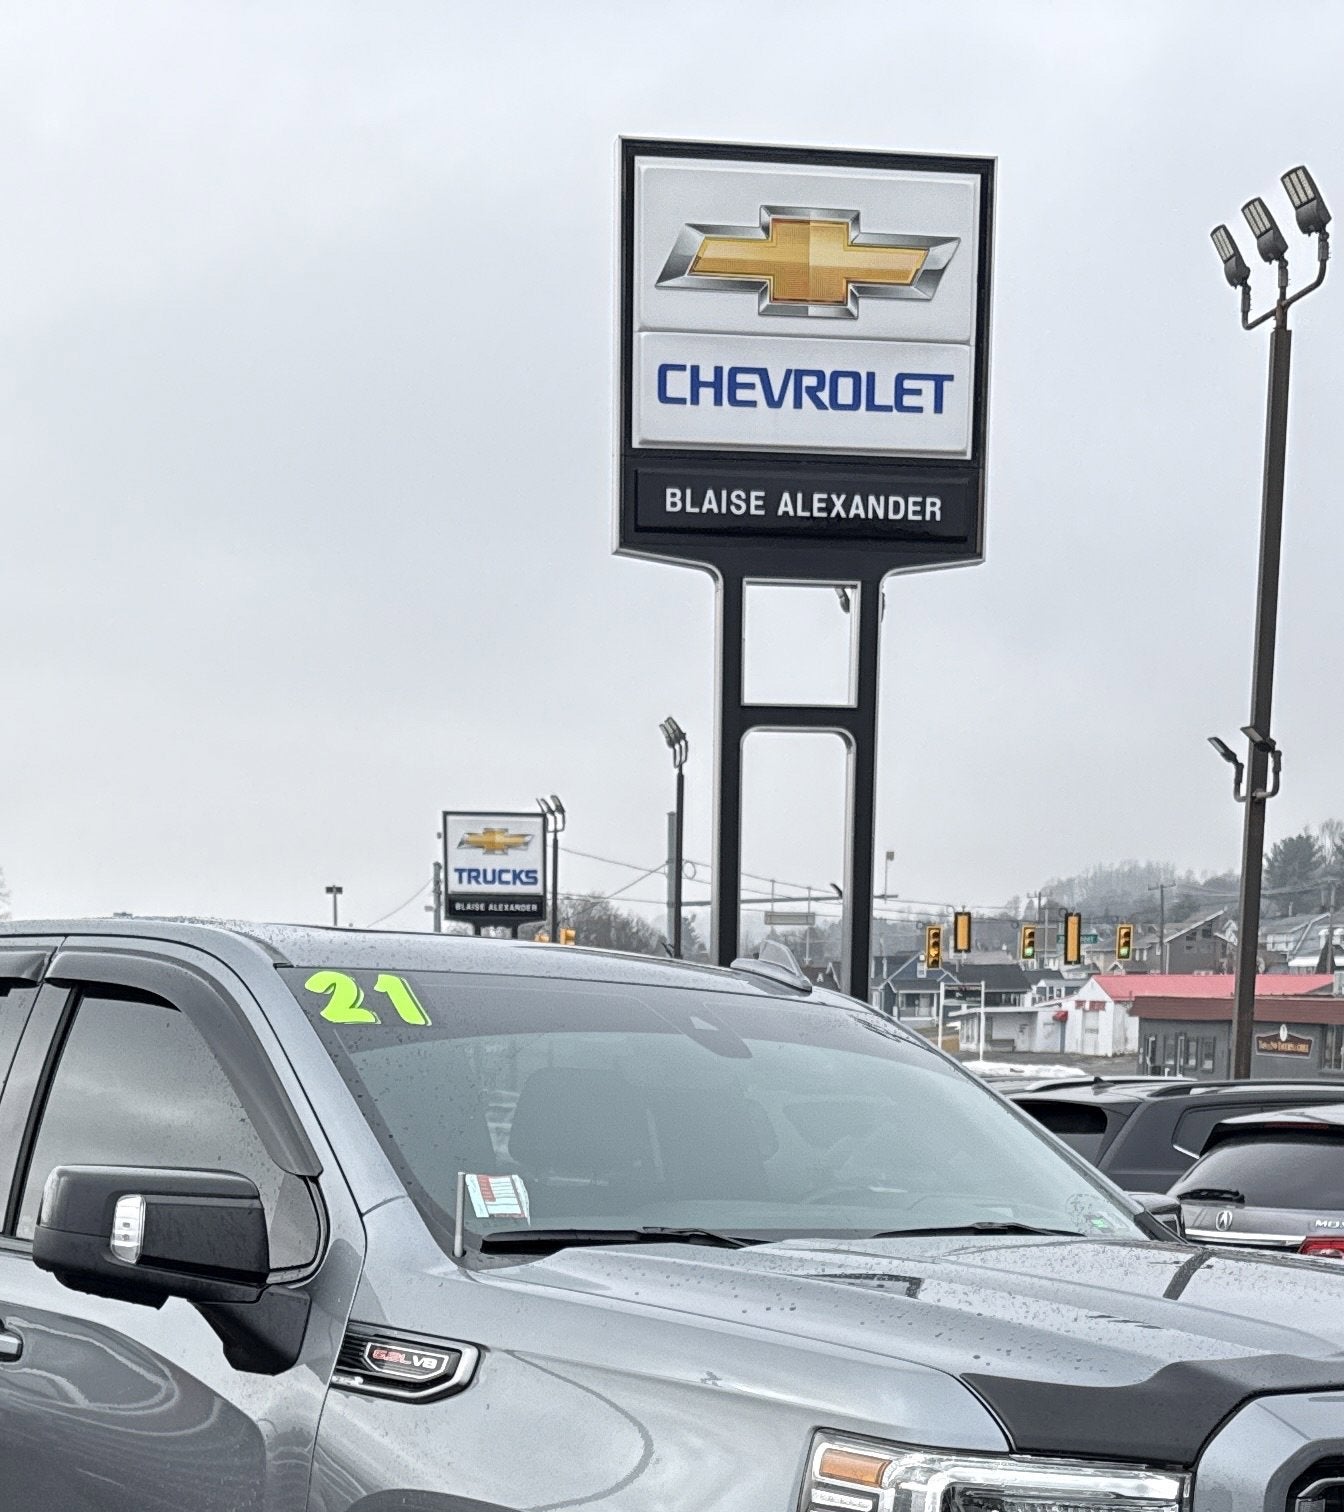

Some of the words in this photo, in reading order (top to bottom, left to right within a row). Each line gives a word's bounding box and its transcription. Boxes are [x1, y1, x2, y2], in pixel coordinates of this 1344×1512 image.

[657, 363, 954, 414] CHEVROLET
[665, 487, 766, 516] BLAISE
[777, 492, 942, 522] ALEXANDER
[454, 868, 538, 886] TRUCKS
[455, 902, 486, 911] BLAISE
[488, 903, 537, 912] ALEXANDER
[305, 971, 432, 1026] 21
